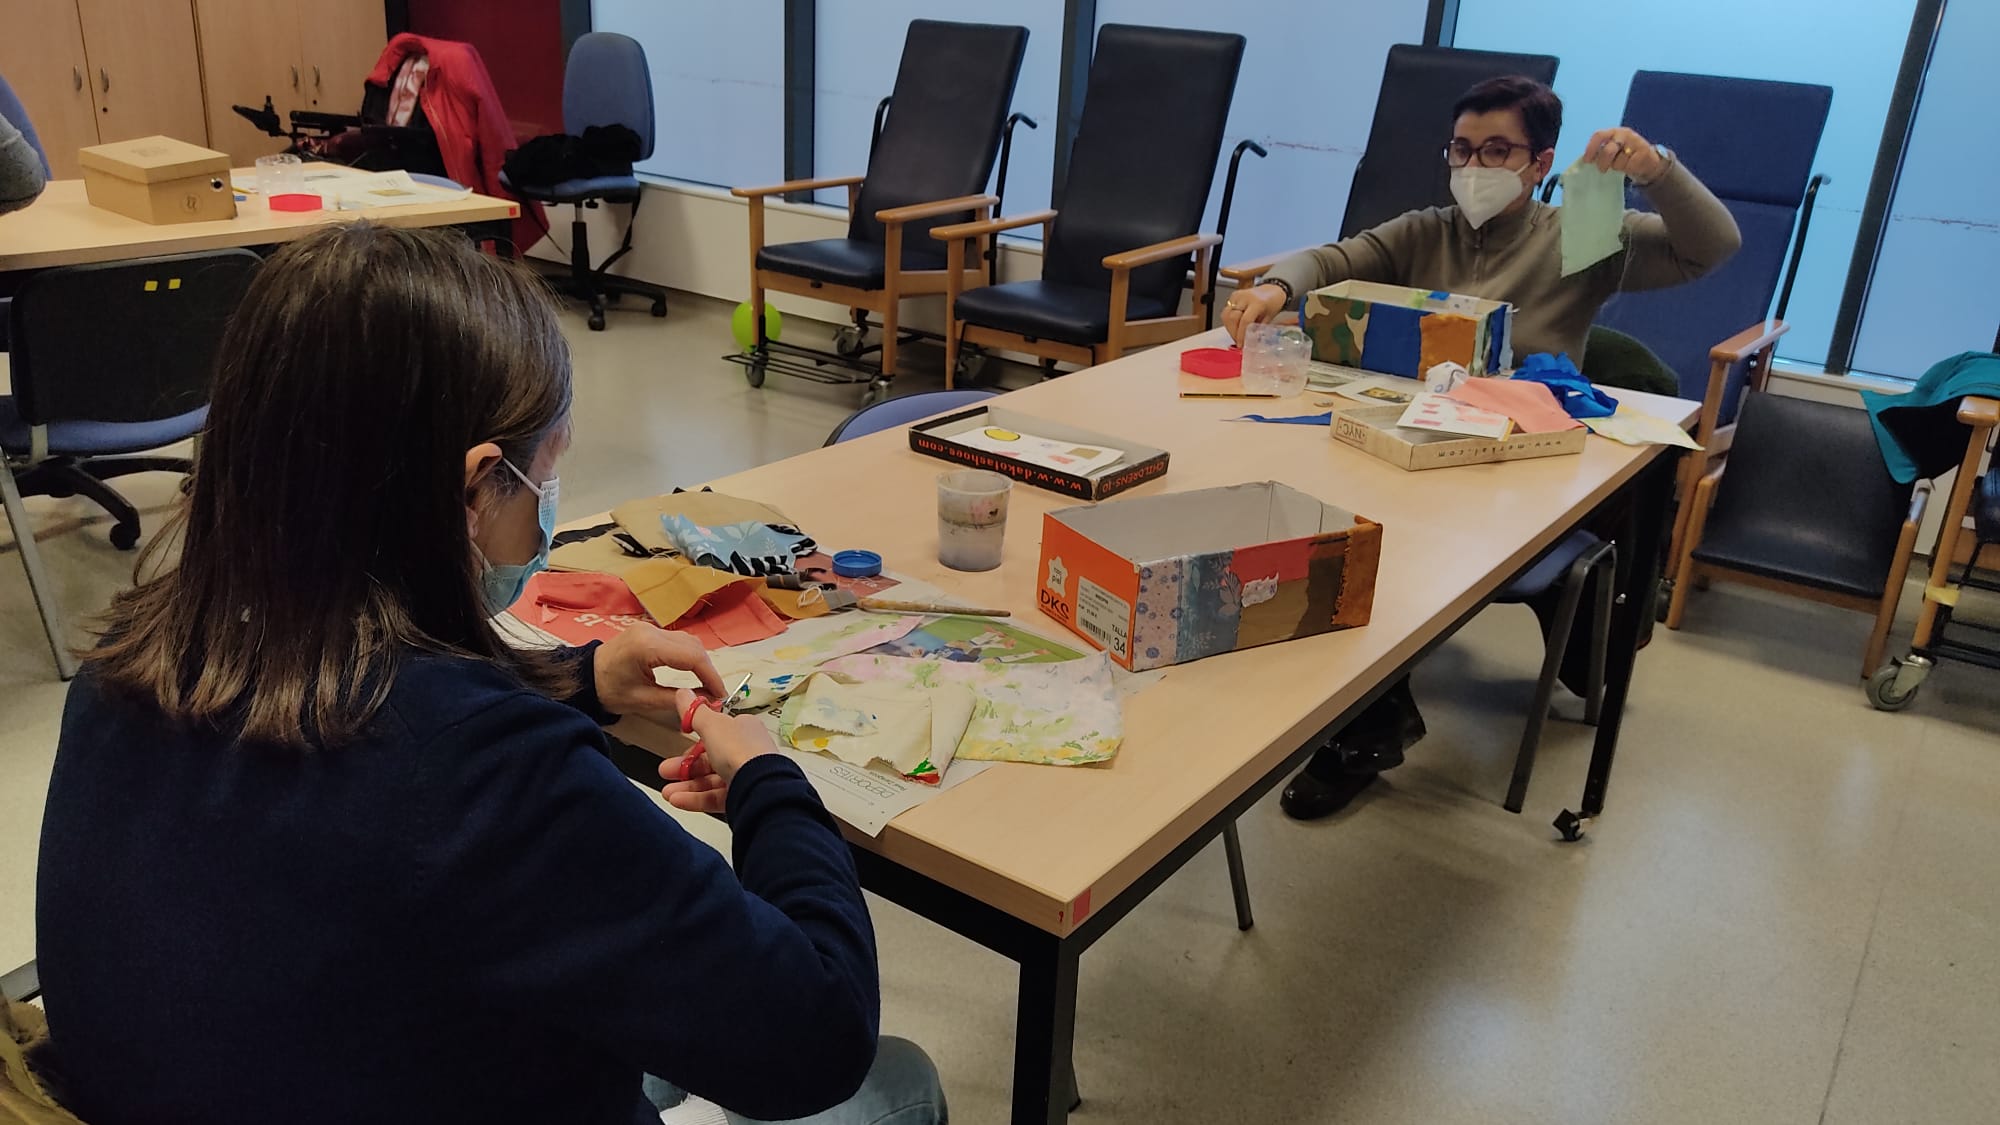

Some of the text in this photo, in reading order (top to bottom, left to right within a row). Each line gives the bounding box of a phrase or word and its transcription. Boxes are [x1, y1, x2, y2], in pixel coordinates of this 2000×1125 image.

[1040, 588, 1069, 619] DKS
[1112, 624, 1127, 638] TALLA
[1114, 637, 1126, 655] 34
[832, 766, 895, 798] DEPORTES
